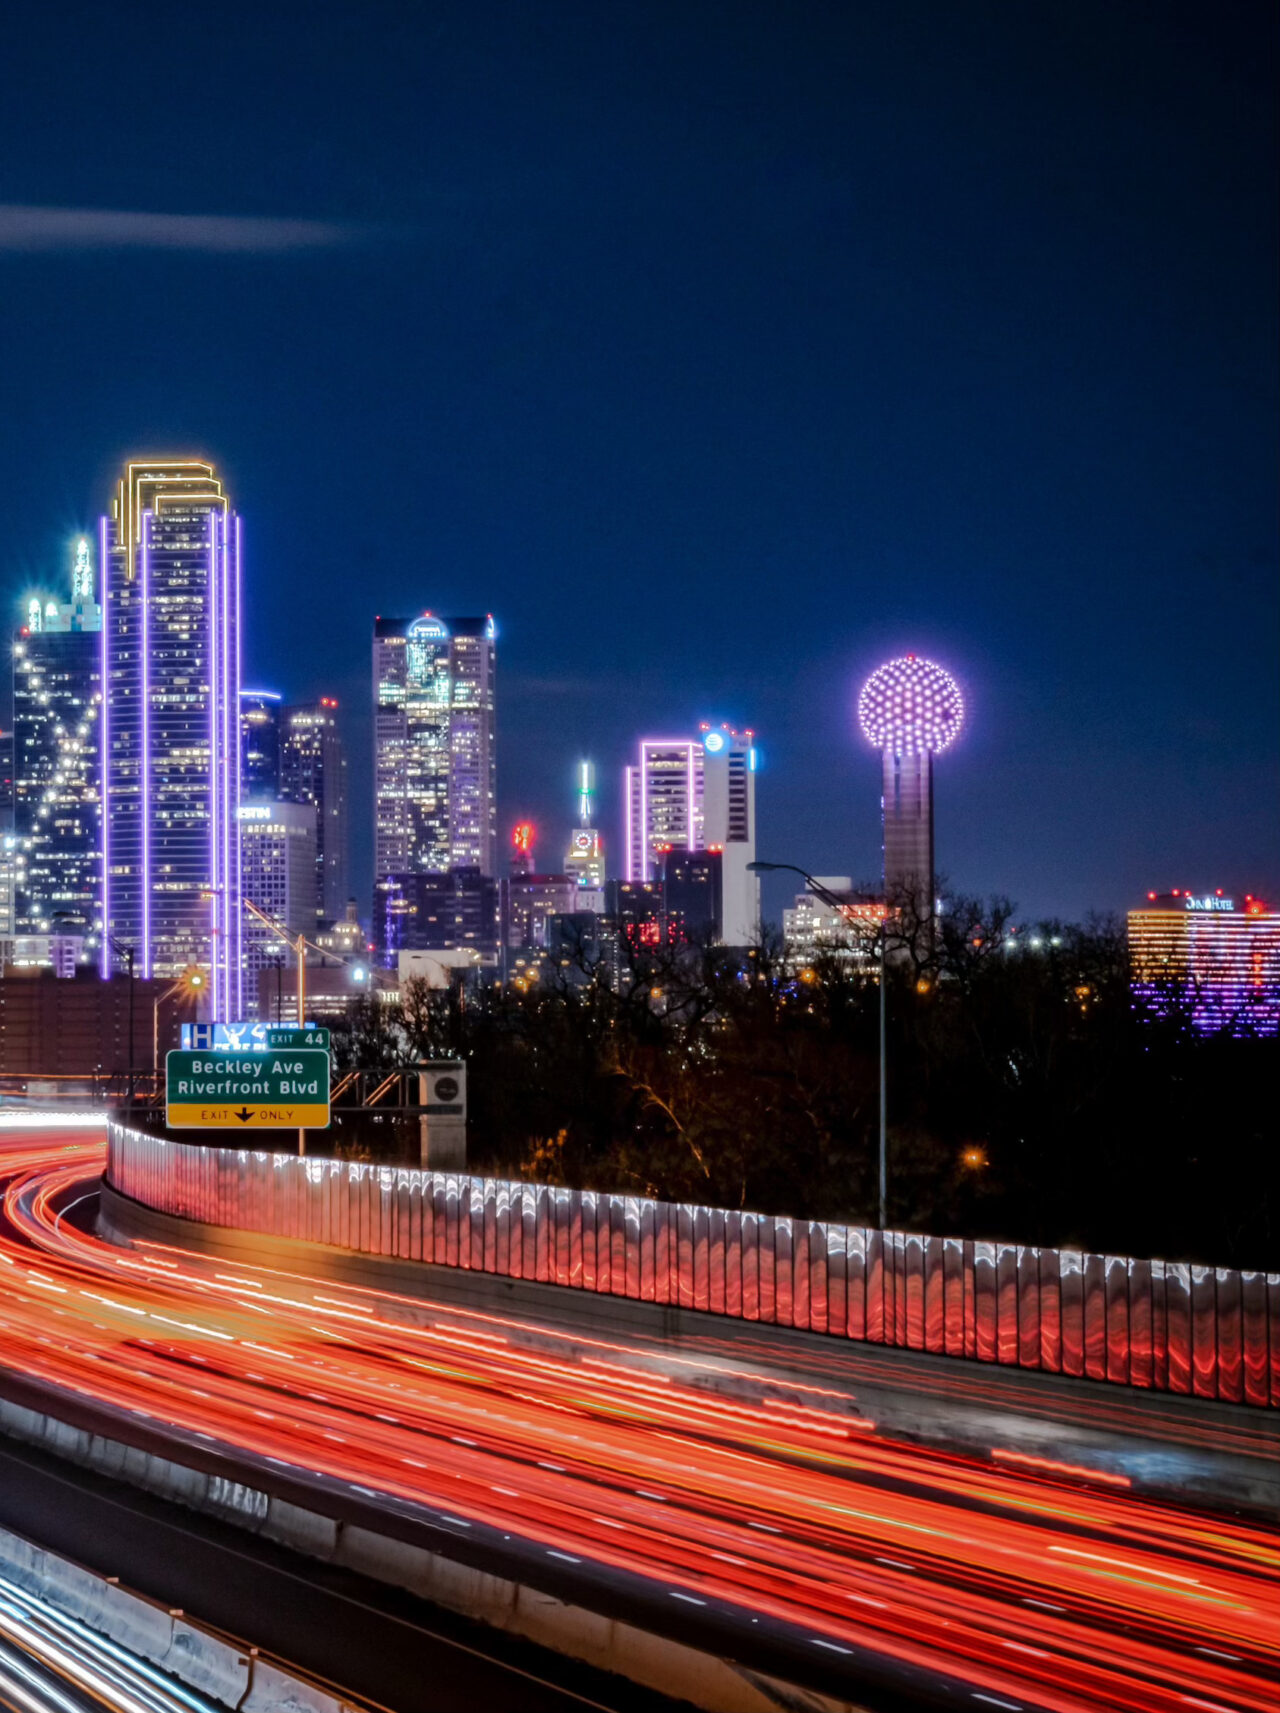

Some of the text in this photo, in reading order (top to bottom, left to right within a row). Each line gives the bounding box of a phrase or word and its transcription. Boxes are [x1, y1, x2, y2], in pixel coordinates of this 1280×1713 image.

[237, 807, 270, 819] ESTIN
[193, 1025, 212, 1048] H
[271, 1033, 324, 1045] EXIT 44
[192, 1060, 304, 1077] Beckley Ave
[178, 1080, 318, 1095] Riverfront Blvd
[201, 1110, 294, 1120] EXIT ONLY
